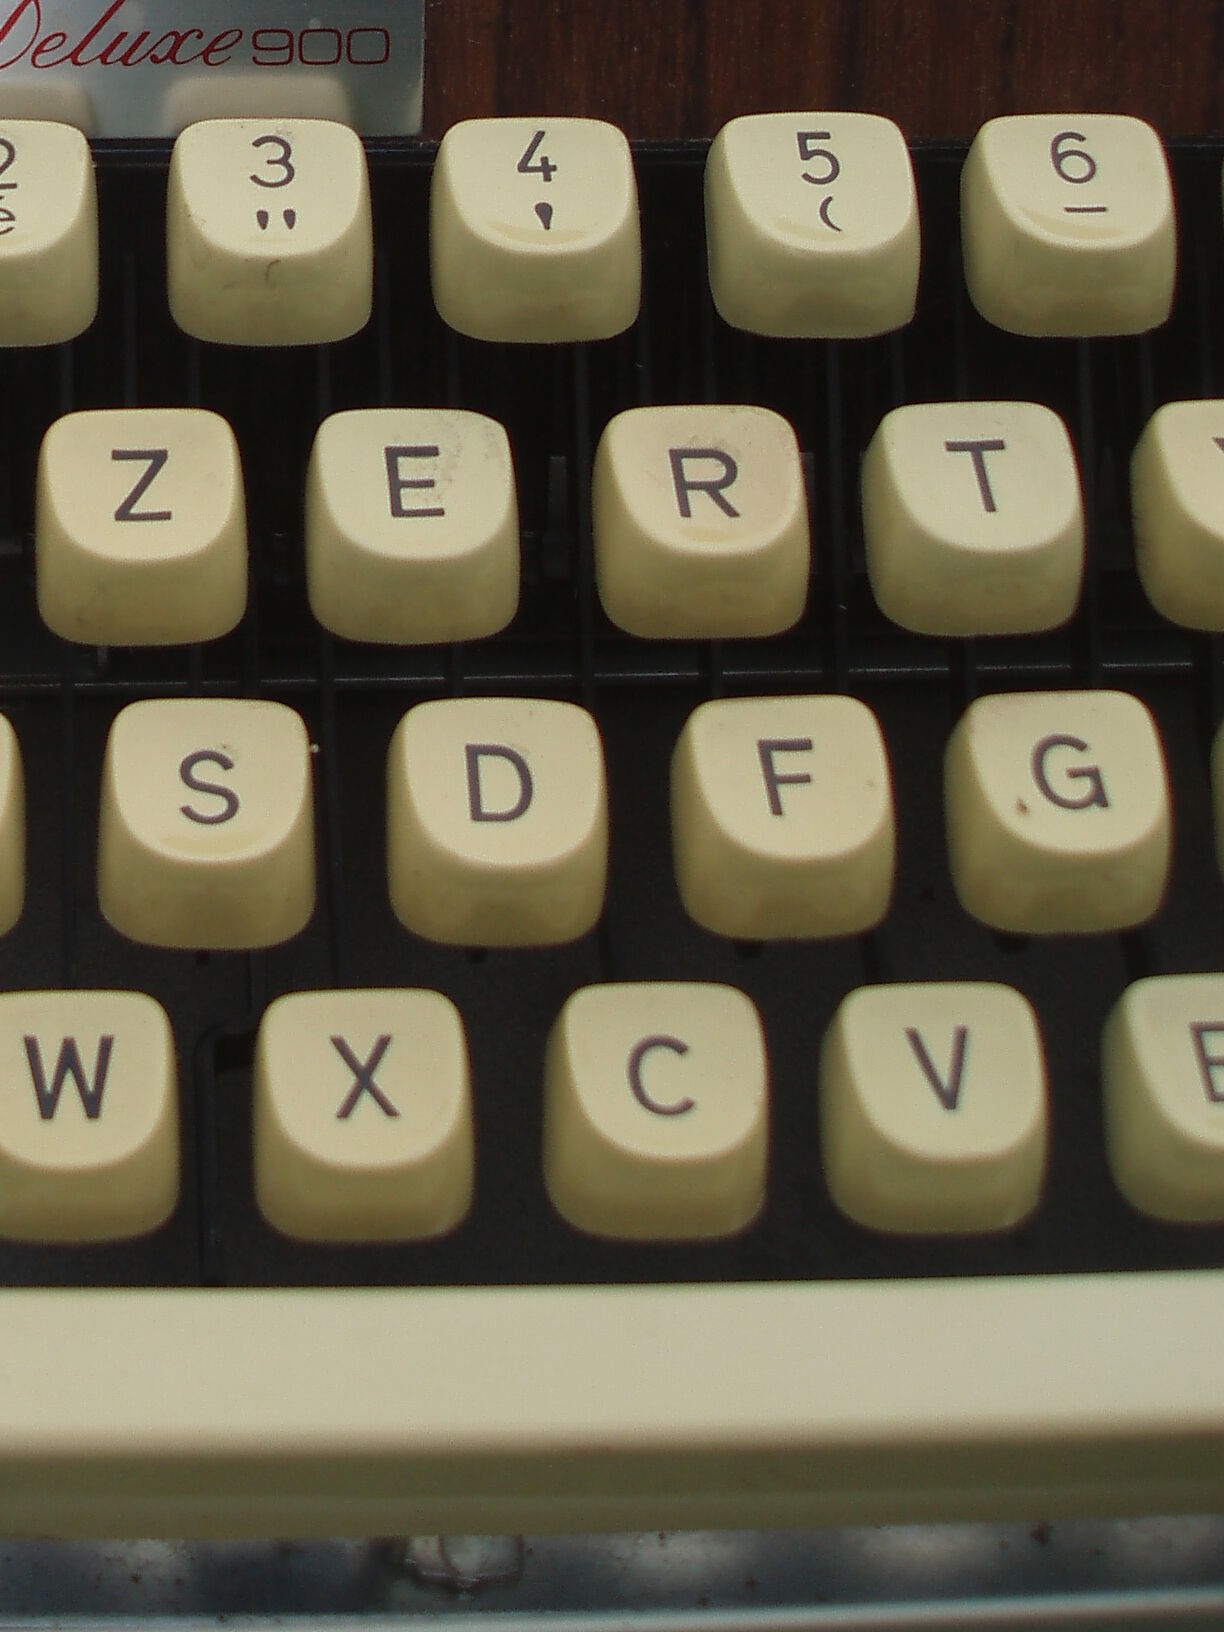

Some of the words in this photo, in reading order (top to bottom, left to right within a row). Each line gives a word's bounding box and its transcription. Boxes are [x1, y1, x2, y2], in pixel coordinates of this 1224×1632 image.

[251, 27, 390, 66] 900
[249, 135, 295, 189] 3
[516, 130, 558, 183] 4
[796, 131, 841, 185] 5
[1050, 131, 1098, 184] 6
[111, 448, 172, 522] Z
[384, 445, 446, 518] E
[668, 446, 741, 519] R
[944, 439, 1007, 513] T
[179, 749, 240, 826] S
[464, 743, 534, 823] D
[756, 738, 814, 817] F
[1030, 733, 1110, 810] G
[23, 1035, 115, 1121] W
[330, 1034, 401, 1121] X
[626, 1035, 696, 1117] C
[904, 1025, 969, 1111] V
